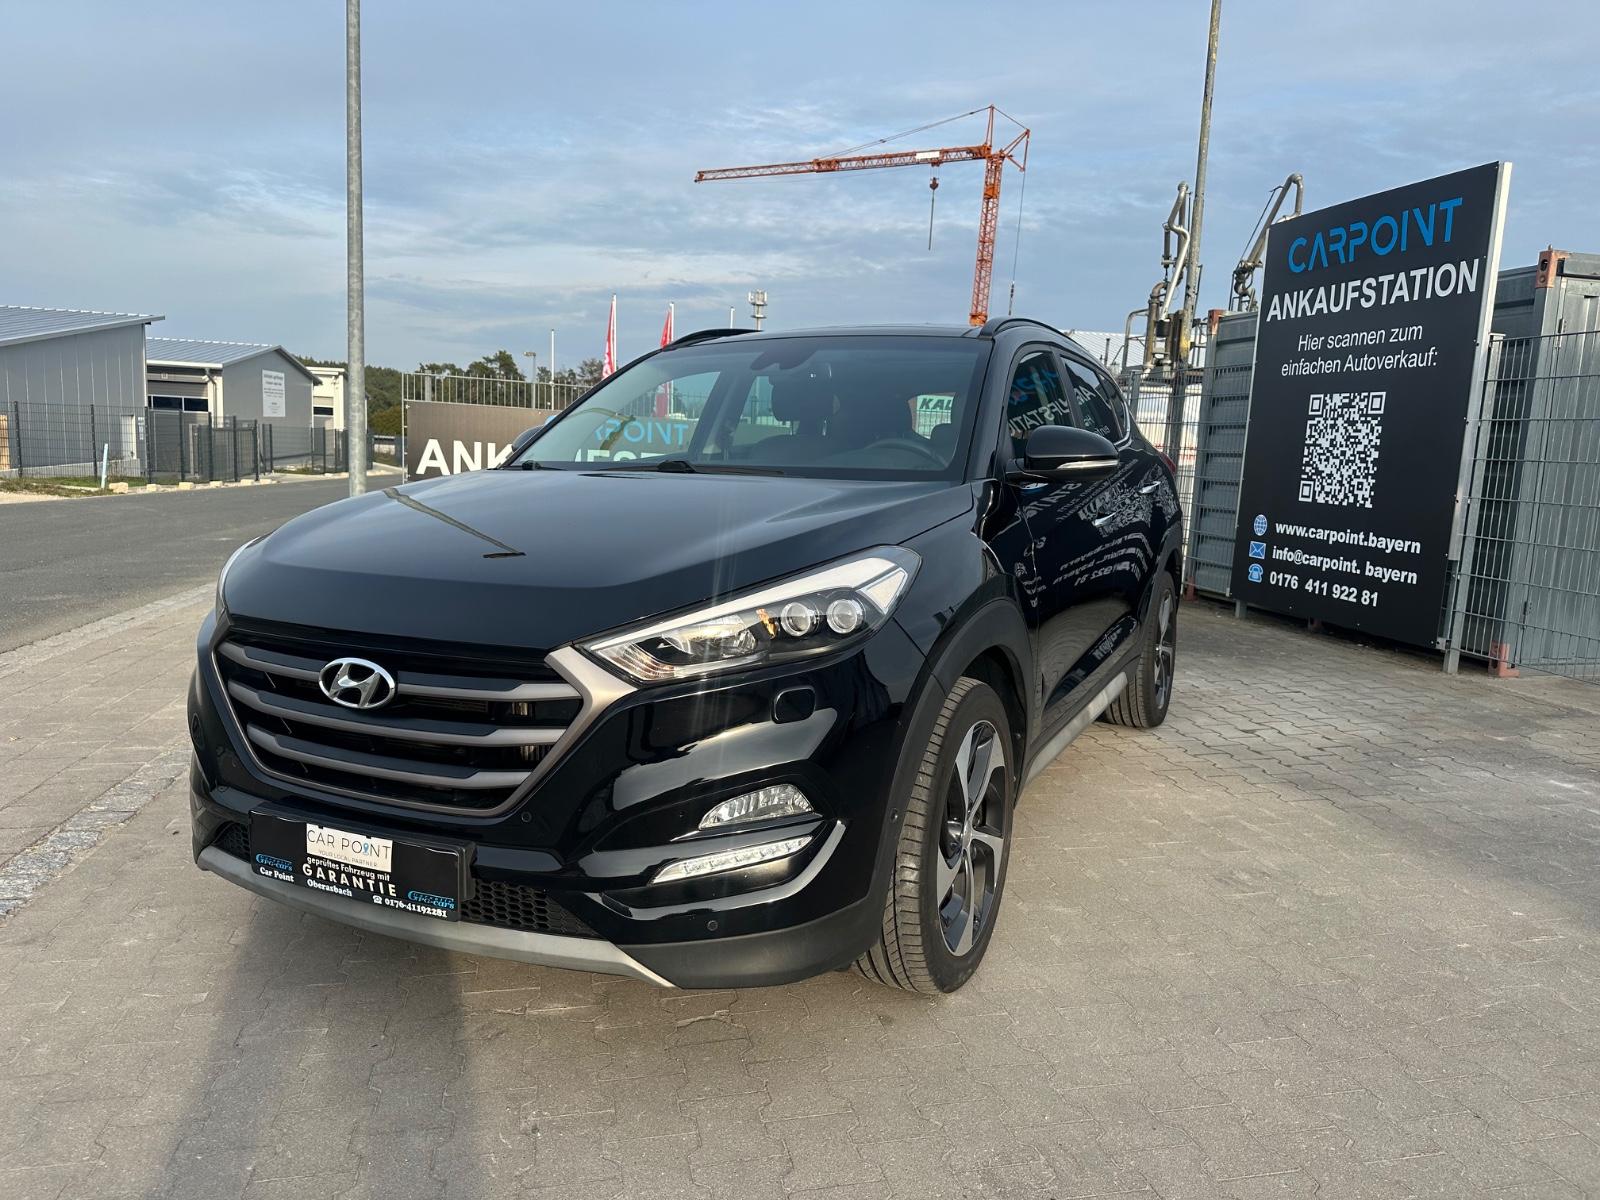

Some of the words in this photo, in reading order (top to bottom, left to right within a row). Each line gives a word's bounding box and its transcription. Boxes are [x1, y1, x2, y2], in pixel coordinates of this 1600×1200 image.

[1288, 197, 1463, 273] CARPOINT
[1266, 258, 1480, 322] ANKAUFSTATION
[1298, 334, 1325, 352] Hier
[1327, 329, 1386, 349] scannen
[1389, 324, 1423, 343] zum
[1281, 355, 1343, 377] einfachen
[1344, 346, 1438, 373] Autoverkauf:
[1275, 521, 1421, 555] www.carpoint.bayern
[1365, 562, 1418, 585] bayern
[1269, 571, 1299, 590] 0176
[1305, 581, 1327, 596] 411
[1332, 585, 1357, 602] 922
[1361, 590, 1378, 607] 81
[307, 829, 335, 848] CAR
[260, 866, 272, 877] Car
[273, 870, 295, 883] Point
[302, 863, 397, 897] GARANTIE
[340, 863, 376, 881] Fahrzeug
[377, 872, 390, 881] mit
[306, 879, 353, 898] Oberasbach
